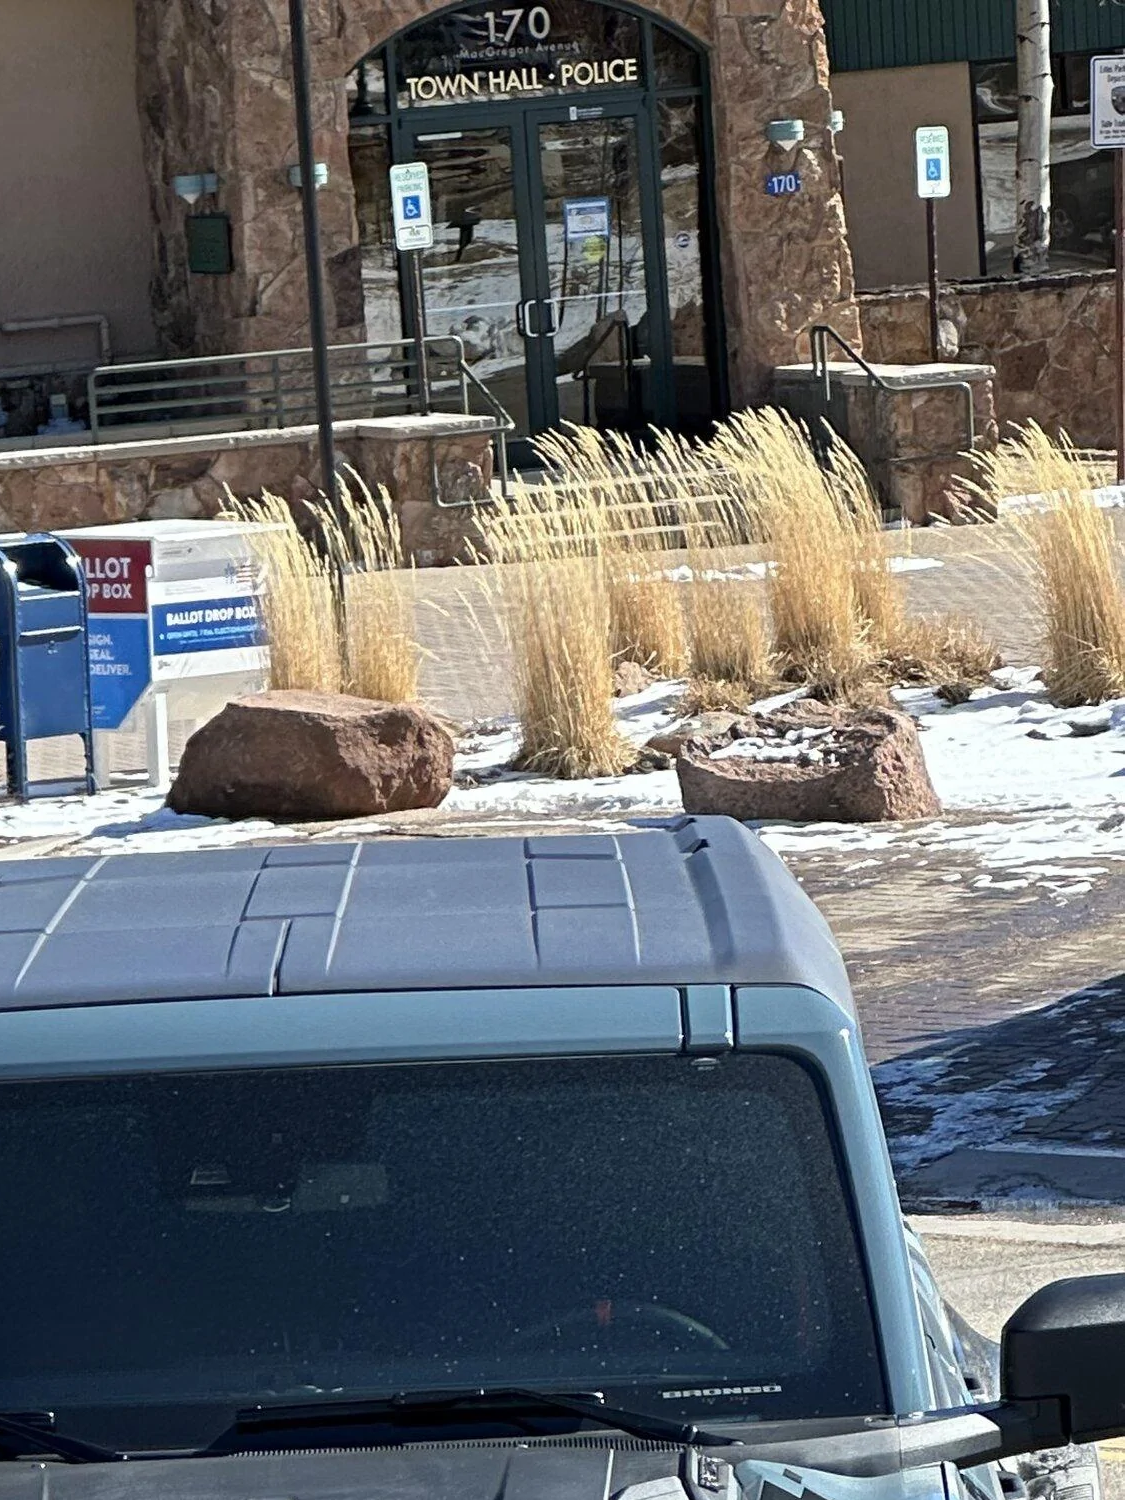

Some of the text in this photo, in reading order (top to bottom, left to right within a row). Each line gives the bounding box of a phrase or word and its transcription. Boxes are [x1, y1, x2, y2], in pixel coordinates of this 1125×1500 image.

[484, 6, 550, 43] 170
[459, 41, 580, 58] MacGregor Avenue
[406, 58, 638, 100] TOWN HALL POLICE
[772, 174, 796, 193] 170
[85, 557, 132, 579] LLOT
[102, 583, 133, 599] BOX
[166, 605, 257, 626] BALLOT DROP BOX
[662, 1385, 782, 1399] BRONCO
